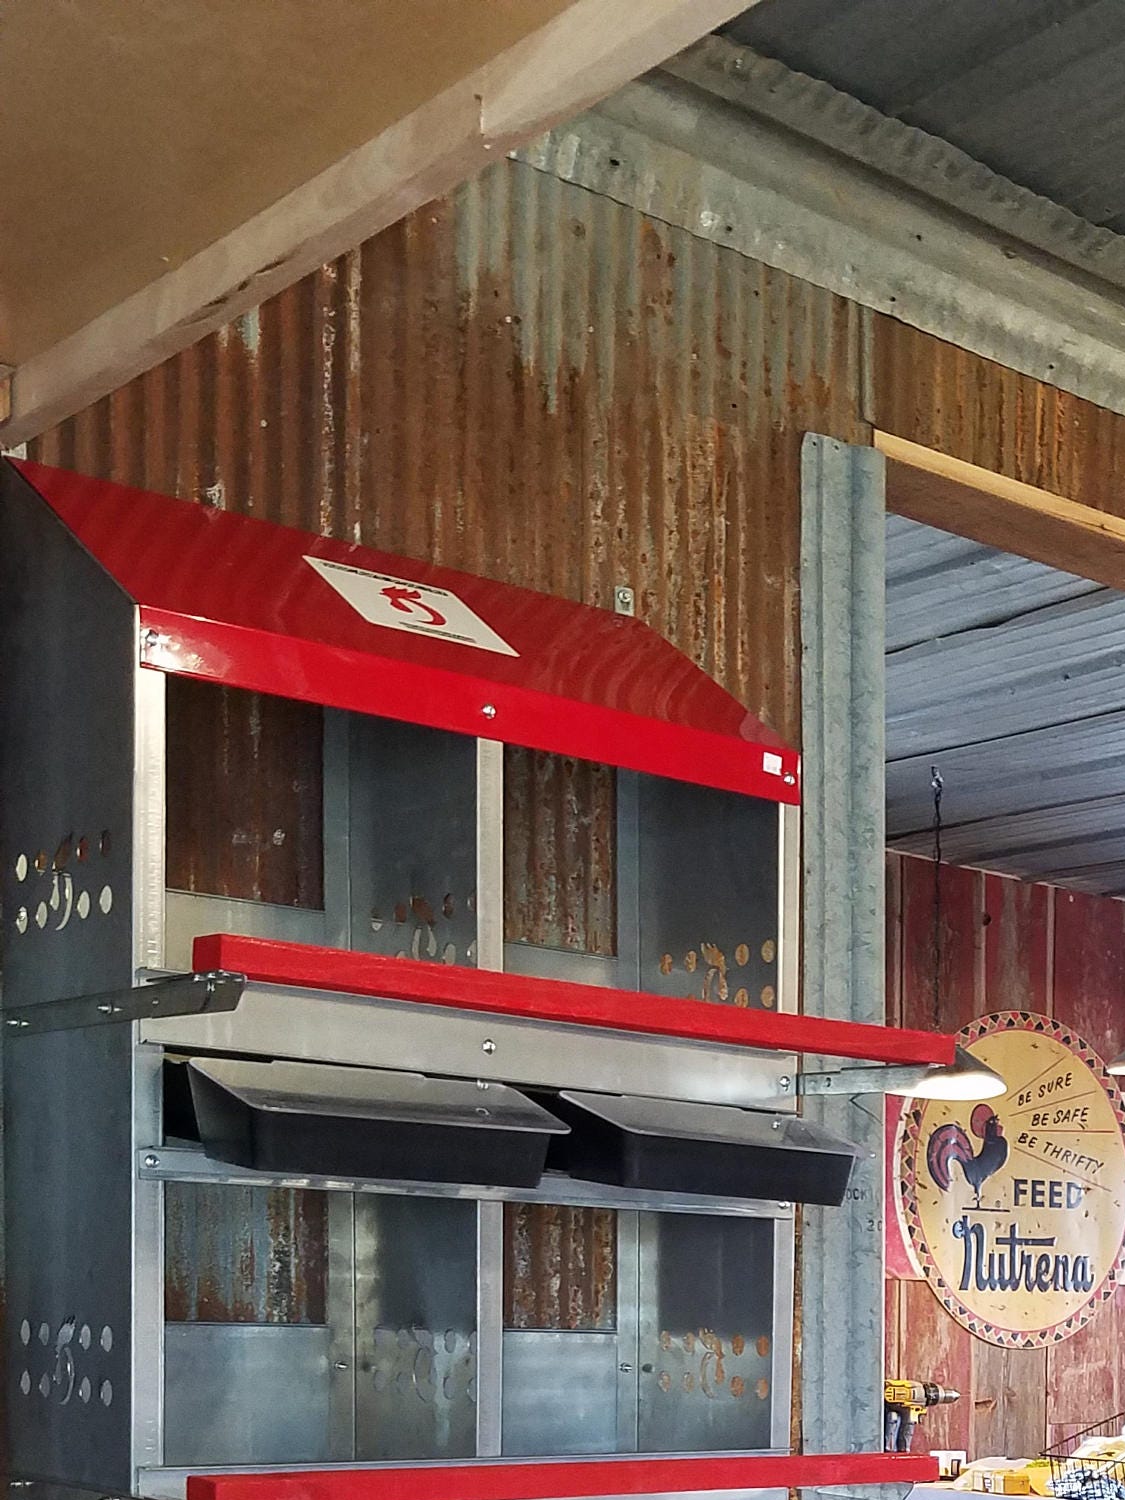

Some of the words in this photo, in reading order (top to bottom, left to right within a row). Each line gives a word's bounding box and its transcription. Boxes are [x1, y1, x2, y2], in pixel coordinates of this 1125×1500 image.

[1017, 1090, 1032, 1106] BE
[1038, 1073, 1073, 1100] SURE
[1031, 1112, 1049, 1127] BE
[1053, 1106, 1090, 1125] SAFE
[1017, 1132, 1036, 1148] BE
[1044, 1142, 1104, 1175] THRIFTY
[1013, 1178, 1083, 1209] FEED
[952, 1215, 1095, 1293] Nutrena
